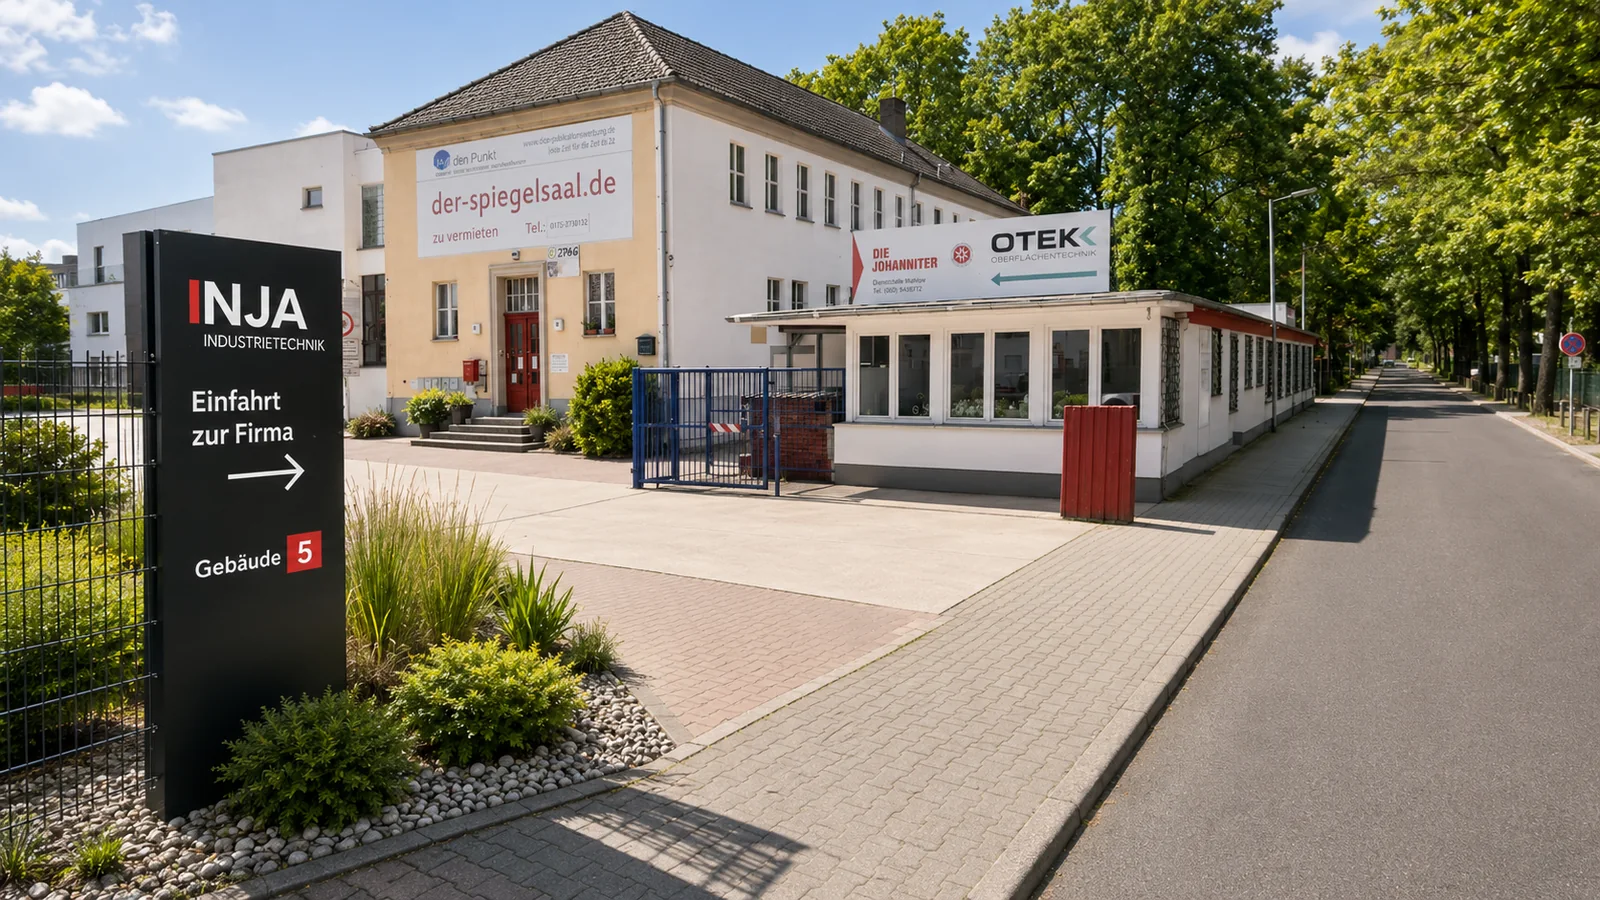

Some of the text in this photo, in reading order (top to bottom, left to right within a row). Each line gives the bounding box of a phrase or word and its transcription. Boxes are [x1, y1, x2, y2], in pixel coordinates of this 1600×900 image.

[453, 155, 469, 167] den
[470, 150, 497, 164] Punkt
[431, 169, 616, 217] der-spiegelsaal.de
[432, 226, 499, 244] zu vermieten
[991, 227, 1081, 253] OTEK
[872, 256, 938, 272] JOHANNITER
[873, 247, 889, 259] DIE
[204, 333, 325, 352] INDUSTRIETECHNIK
[192, 388, 281, 413] Einfahrt
[192, 422, 294, 447] zur Firma
[195, 539, 313, 578] Gebäude 5
